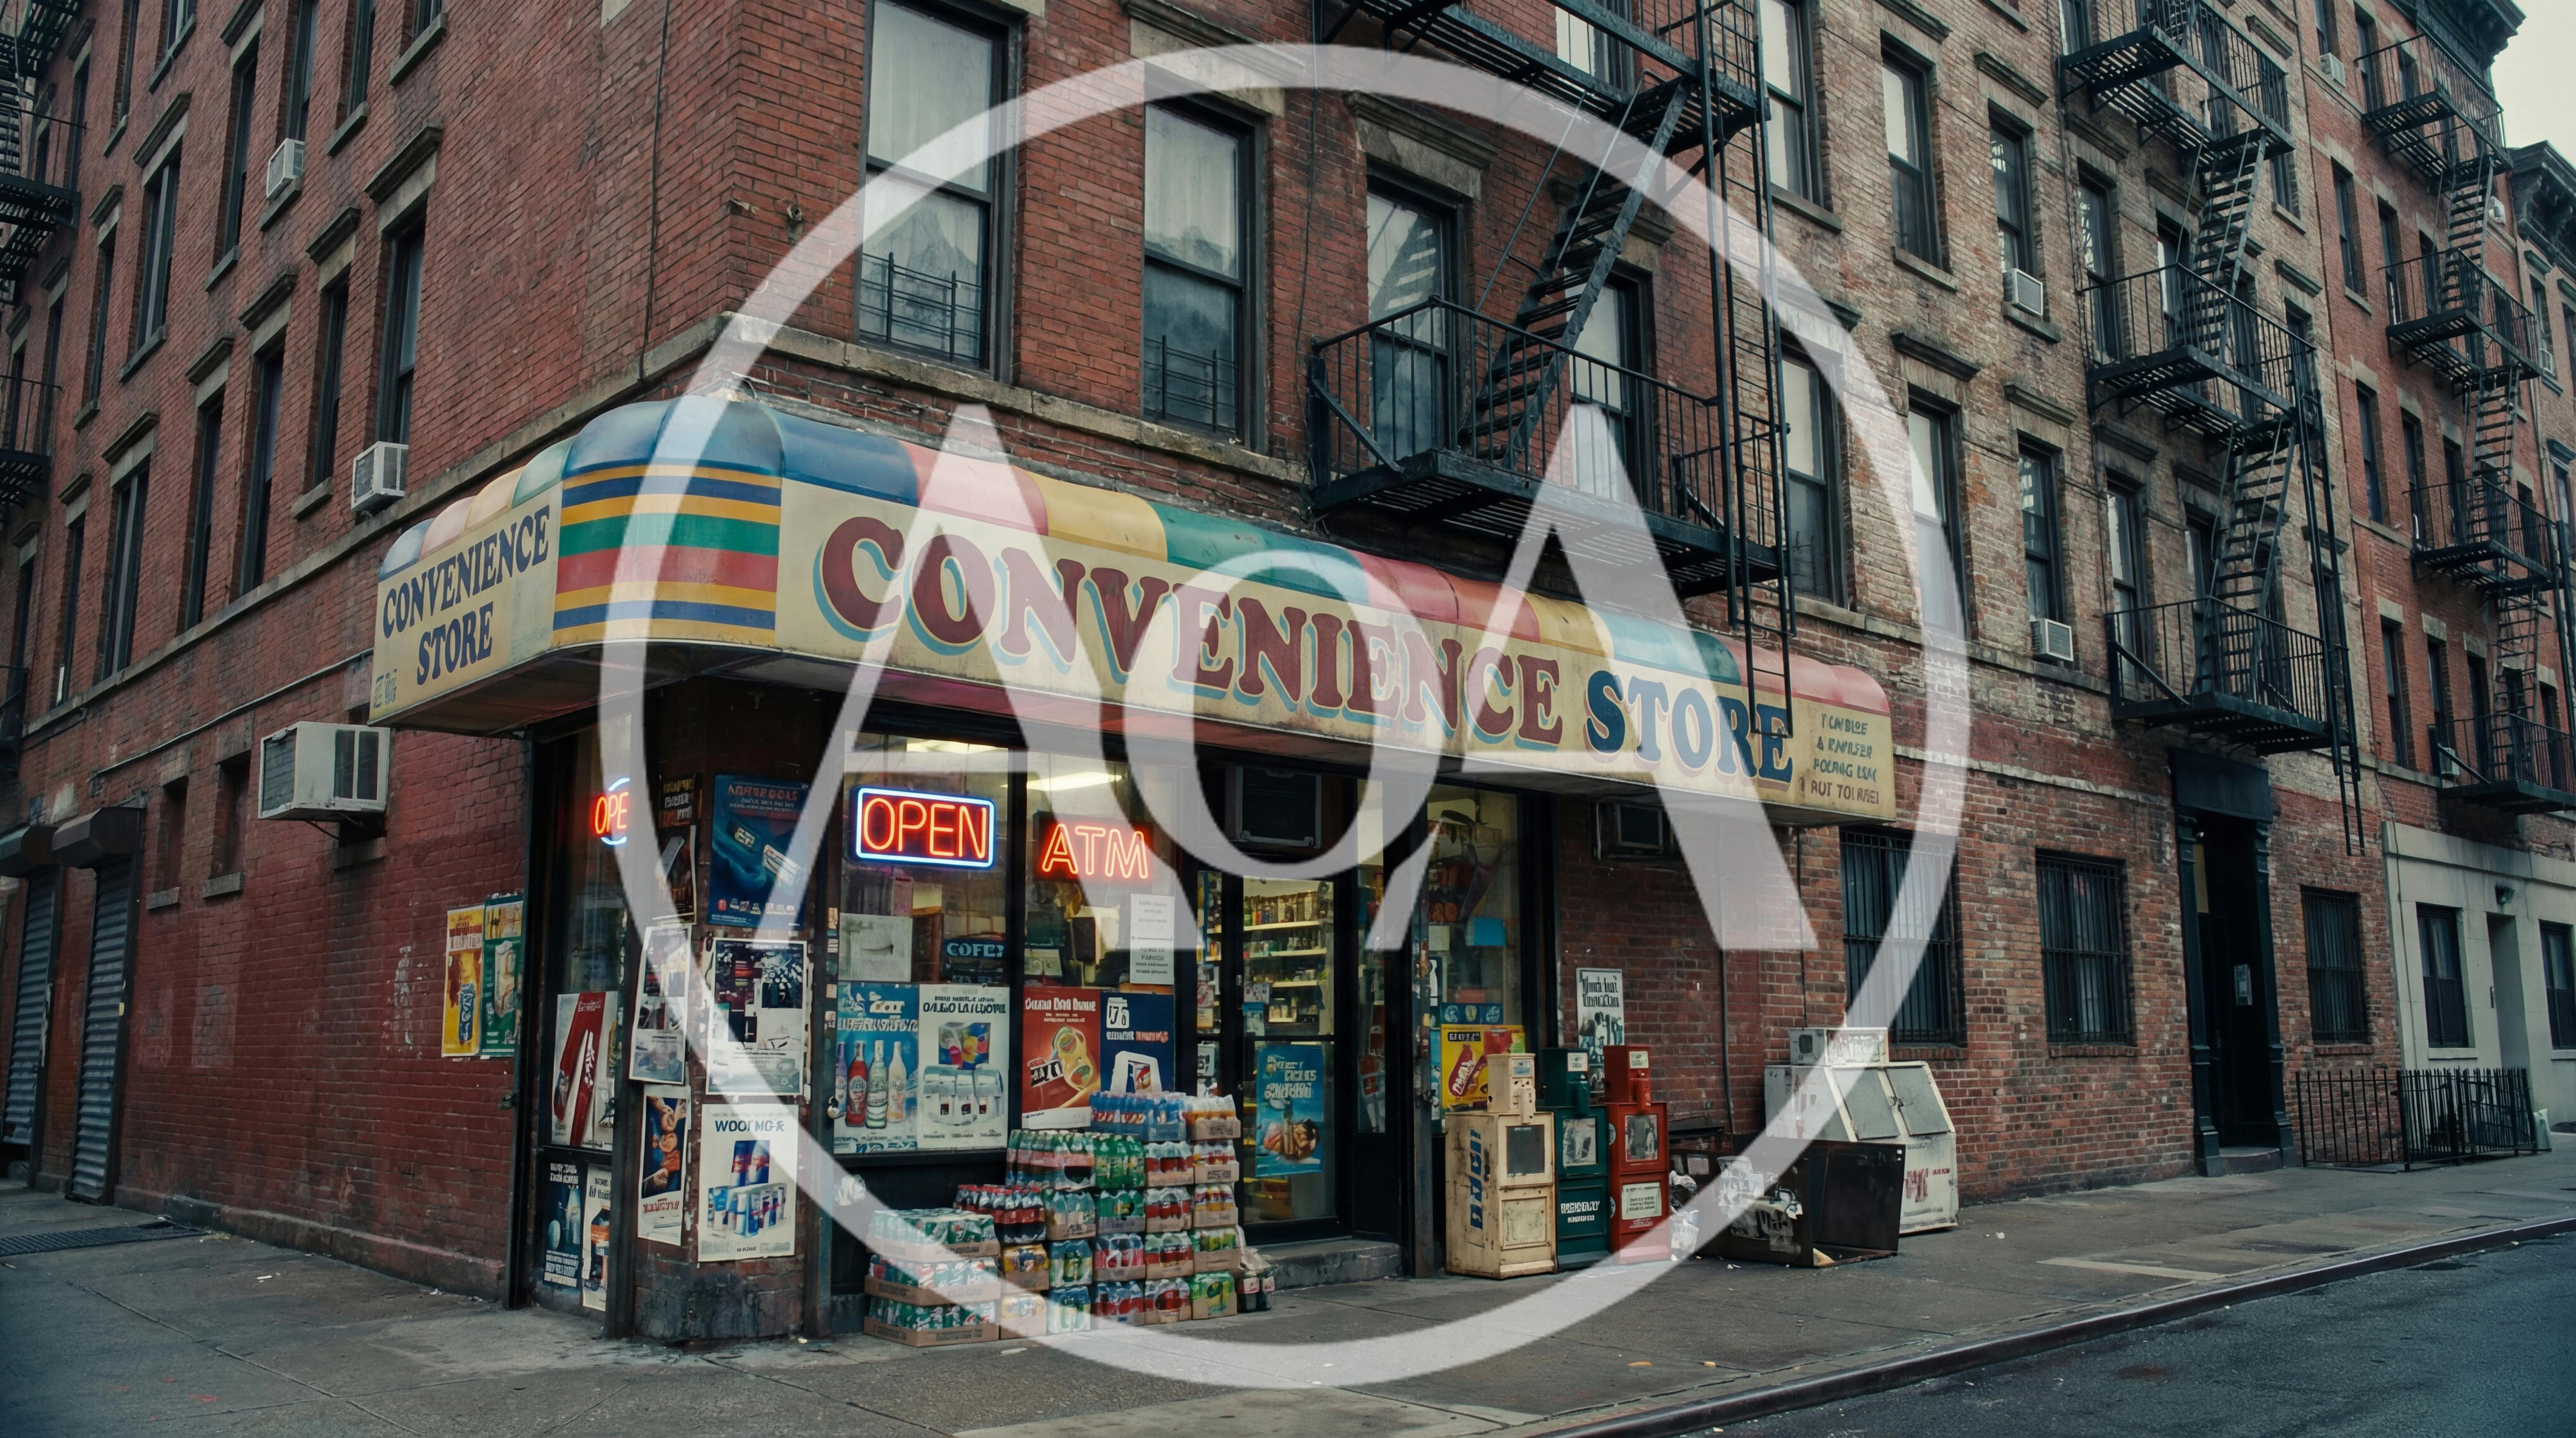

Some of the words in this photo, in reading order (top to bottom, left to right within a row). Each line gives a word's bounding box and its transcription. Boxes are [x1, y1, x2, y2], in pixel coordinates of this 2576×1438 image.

[383, 505, 550, 638] CONVENIENCE
[417, 601, 493, 685] STORE
[813, 516, 1563, 752] CONVENIENCE
[1584, 670, 1793, 791] STORE
[595, 792, 629, 834] OPE
[863, 798, 987, 859] OPEN
[1042, 823, 1149, 879] ATM
